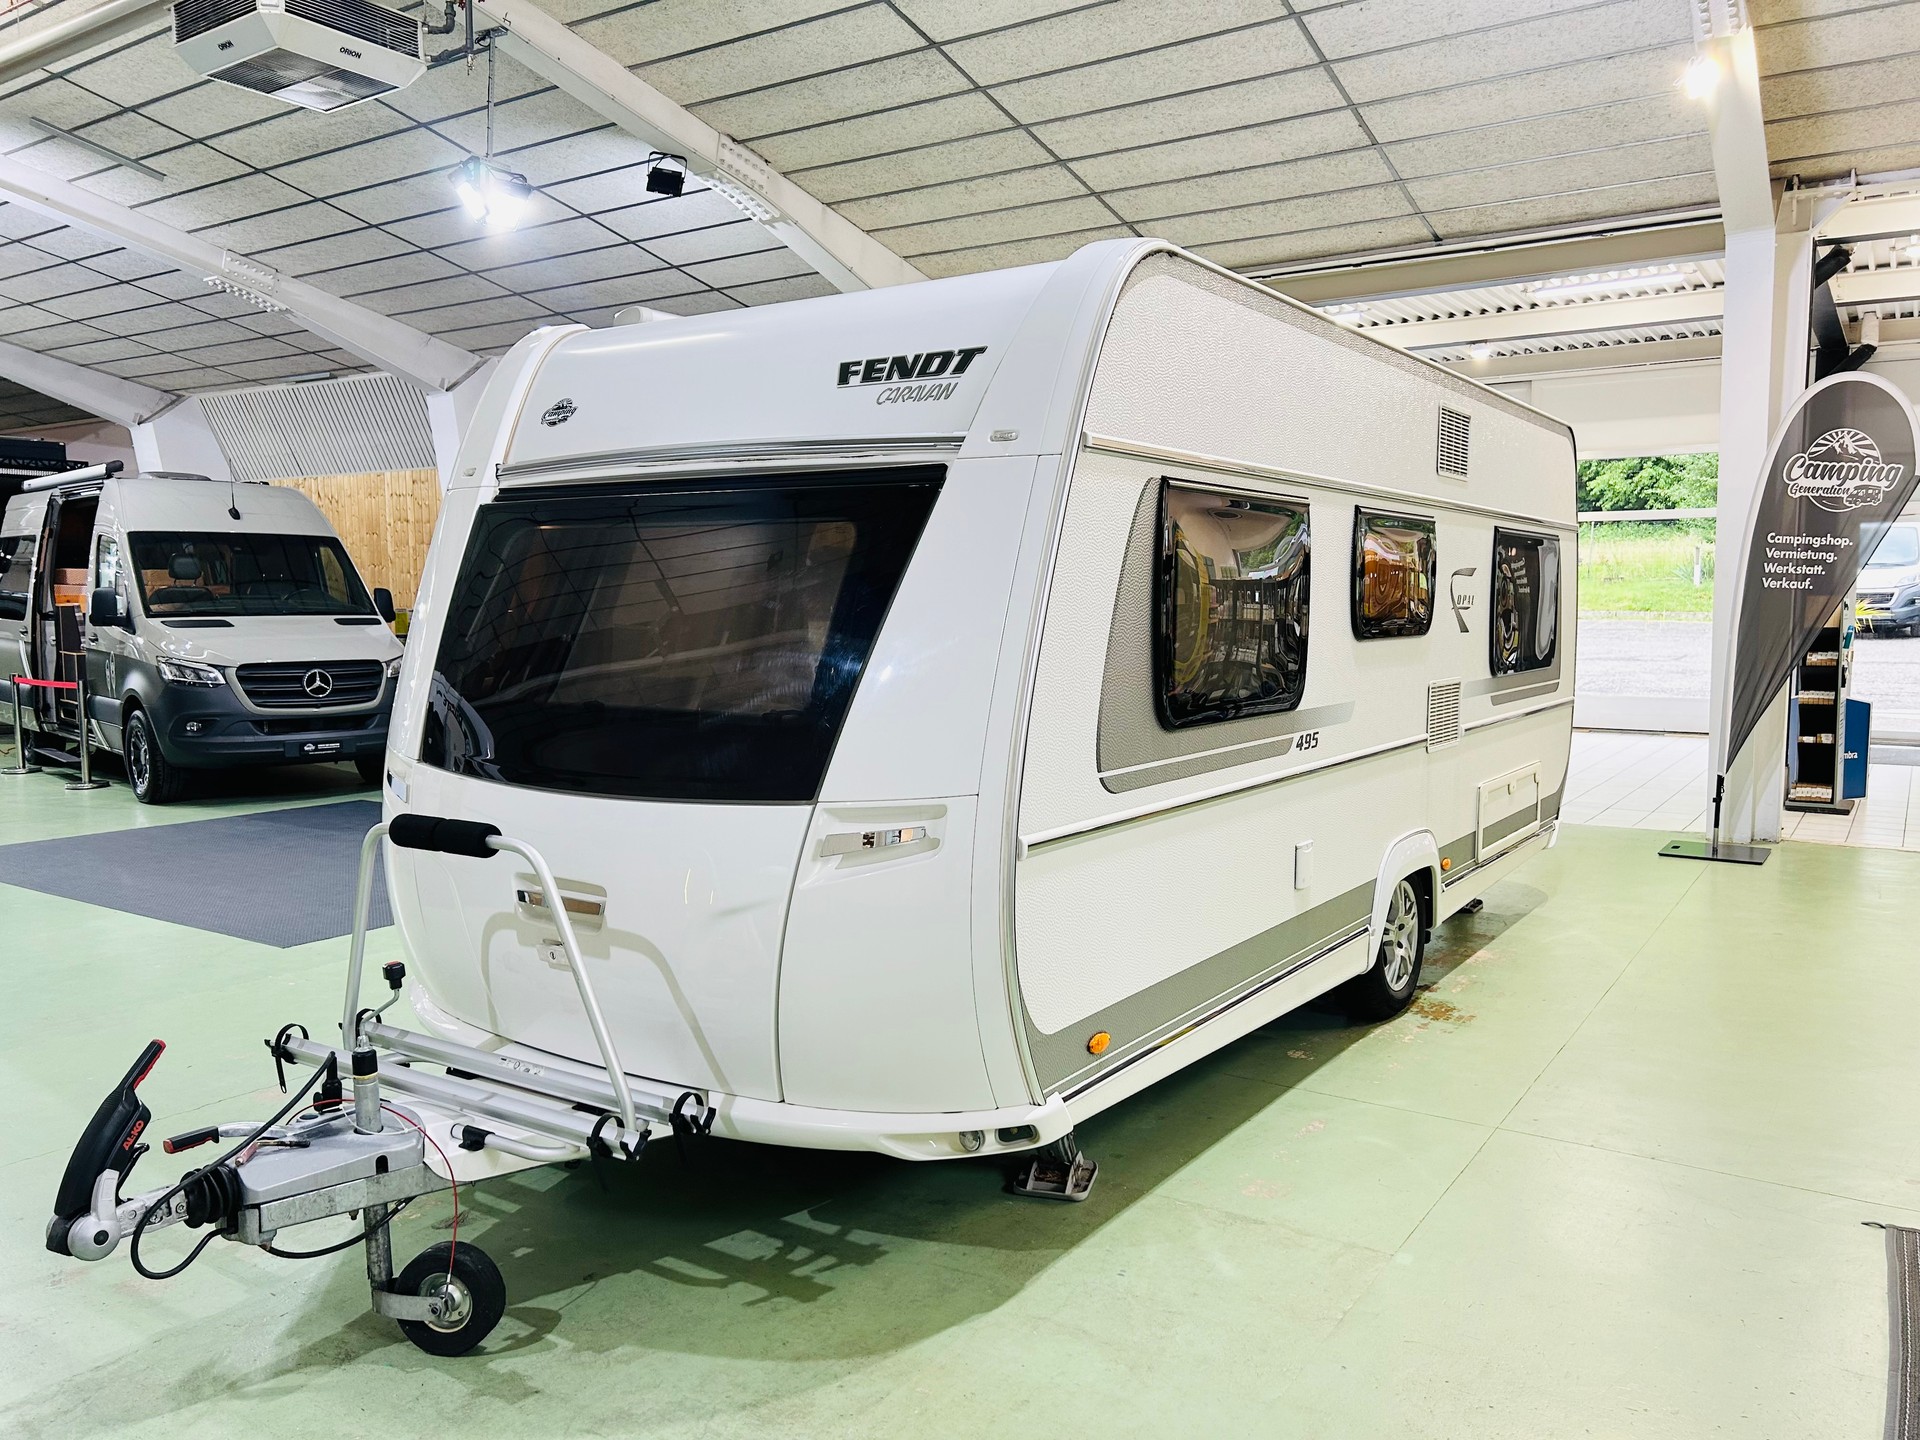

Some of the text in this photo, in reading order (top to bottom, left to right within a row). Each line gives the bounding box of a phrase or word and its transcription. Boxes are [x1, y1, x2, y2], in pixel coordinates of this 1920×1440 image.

[340, 47, 361, 59] ORION
[836, 345, 989, 386] FENDT
[876, 381, 959, 405] CARAVAN
[1783, 454, 1903, 491] Camping
[1789, 482, 1851, 497] Generation
[1766, 532, 1854, 549] Campingshop.
[1765, 548, 1838, 563] Vermietung.
[1763, 562, 1826, 575] Werkstatt.
[1761, 577, 1814, 590] Verkauf.
[1456, 594, 1475, 606] OPAL
[1295, 731, 1320, 751] 495
[123, 1120, 144, 1150] AL-KO
